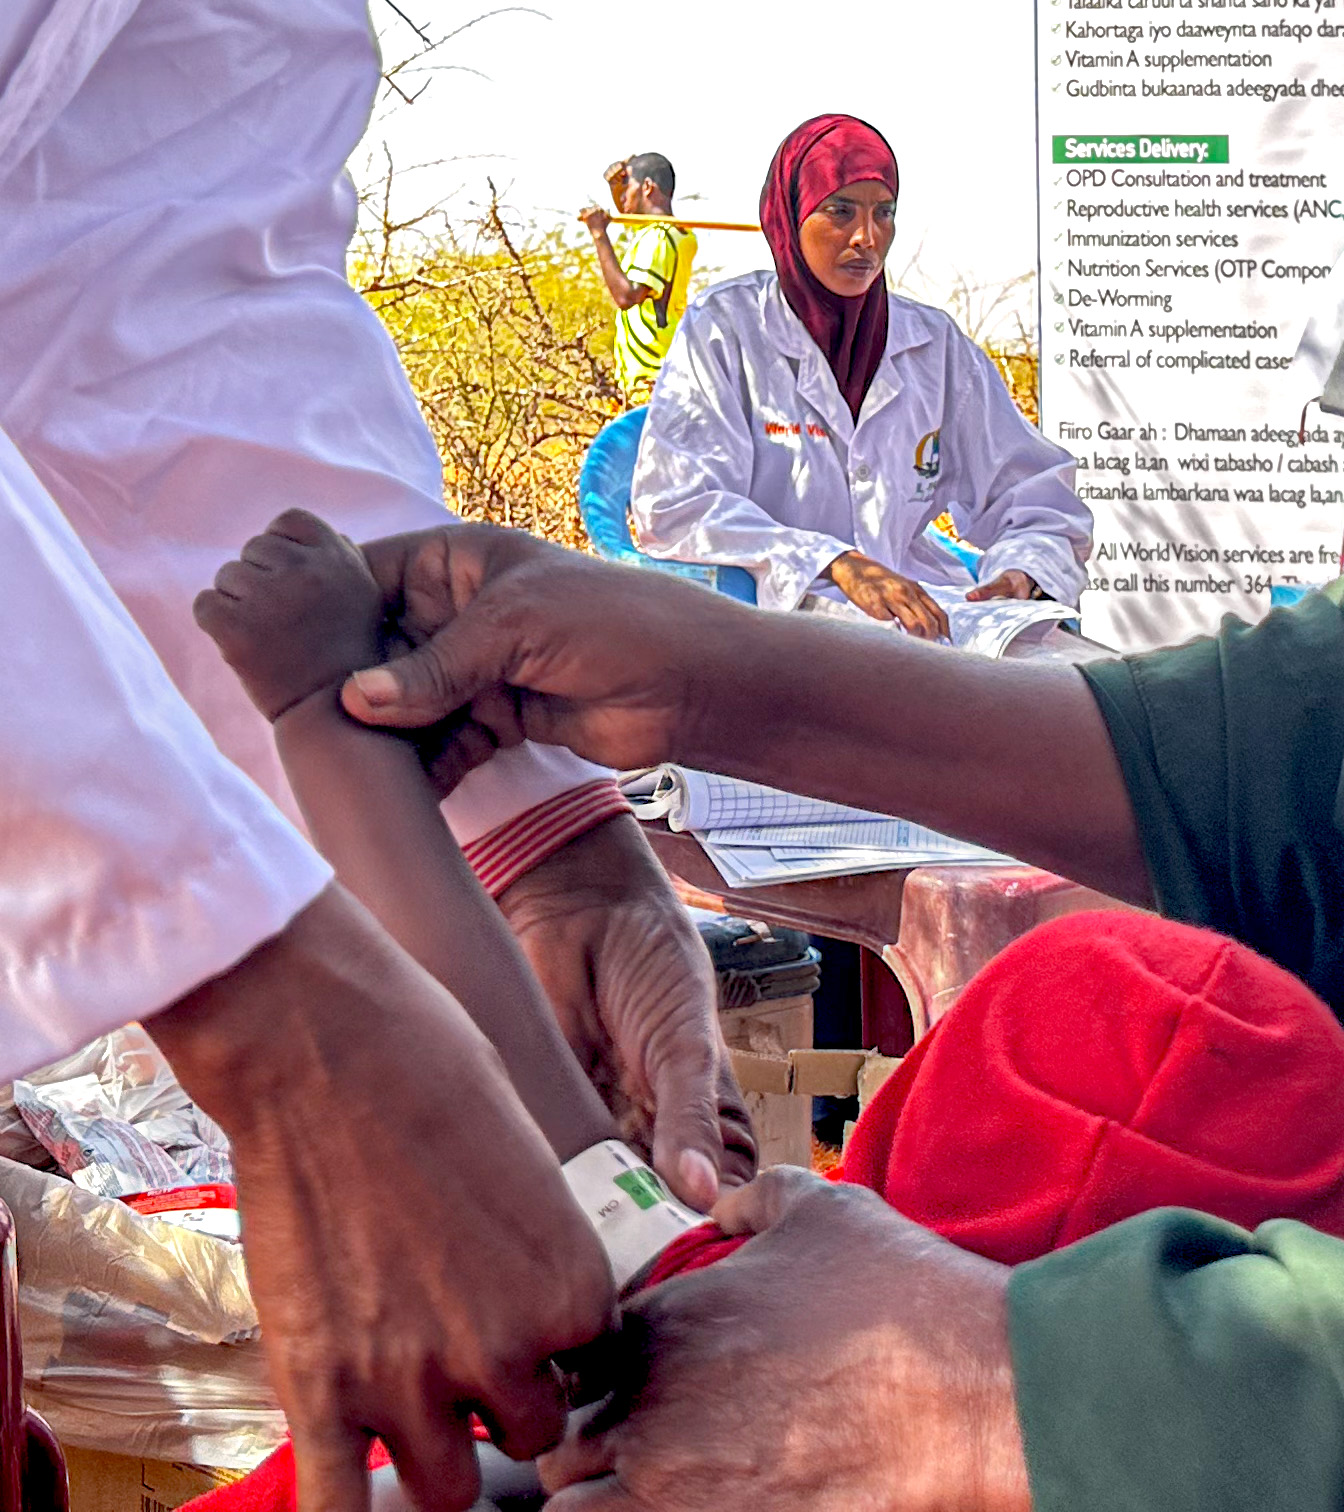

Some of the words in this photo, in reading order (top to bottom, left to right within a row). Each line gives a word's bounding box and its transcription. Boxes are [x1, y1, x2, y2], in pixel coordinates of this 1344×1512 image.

[1066, 21, 1143, 43] Kahortaga
[1150, 22, 1171, 43] iyo
[1177, 20, 1256, 42] daaweynta
[1262, 19, 1312, 42] nafaqo
[1065, 50, 1123, 67] Vitamin
[1126, 50, 1139, 67] A
[1145, 50, 1272, 72] supplementation
[1067, 80, 1136, 97] Gudbinta
[1142, 79, 1221, 96] bukaanada
[1227, 78, 1306, 102] adeegyada
[1065, 138, 1135, 158] Services
[1067, 170, 1106, 187] OPD
[1112, 169, 1210, 187] Consultation
[1216, 170, 1243, 187] and
[1249, 173, 1327, 188] treatment
[1068, 200, 1169, 221] Reproductive
[1175, 199, 1221, 217] health
[1227, 200, 1288, 218] services
[1068, 230, 1170, 247] Immunization
[1177, 231, 1238, 247] services
[1069, 259, 1140, 276] Nutrition
[1146, 259, 1209, 277] Services
[1215, 260, 1257, 281] (OTP
[1069, 290, 1172, 312] De-Worming
[1069, 320, 1126, 337] Vitamin
[1130, 320, 1143, 337] A
[1149, 320, 1277, 341] supplementation
[1070, 350, 1130, 368] Referral
[1136, 350, 1152, 368] of
[1157, 351, 1250, 373] complicated
[1098, 421, 1135, 440] Gaar
[1140, 423, 1157, 440] ah
[1175, 423, 1246, 441] Dhamaan
[1251, 421, 1329, 446] adeegada
[1094, 452, 1130, 475] lacag
[1214, 453, 1273, 472] tabasho
[1288, 454, 1338, 472] cabash
[1234, 490, 1264, 502] waa
[1269, 484, 1306, 508] lacag
[1097, 543, 1117, 560] All
[1121, 542, 1171, 562] World
[1171, 542, 1219, 563] Vision
[1223, 545, 1285, 563] services
[1290, 551, 1313, 564] are
[1115, 574, 1138, 591] call
[1143, 573, 1169, 592] this
[1175, 575, 1235, 593] number
